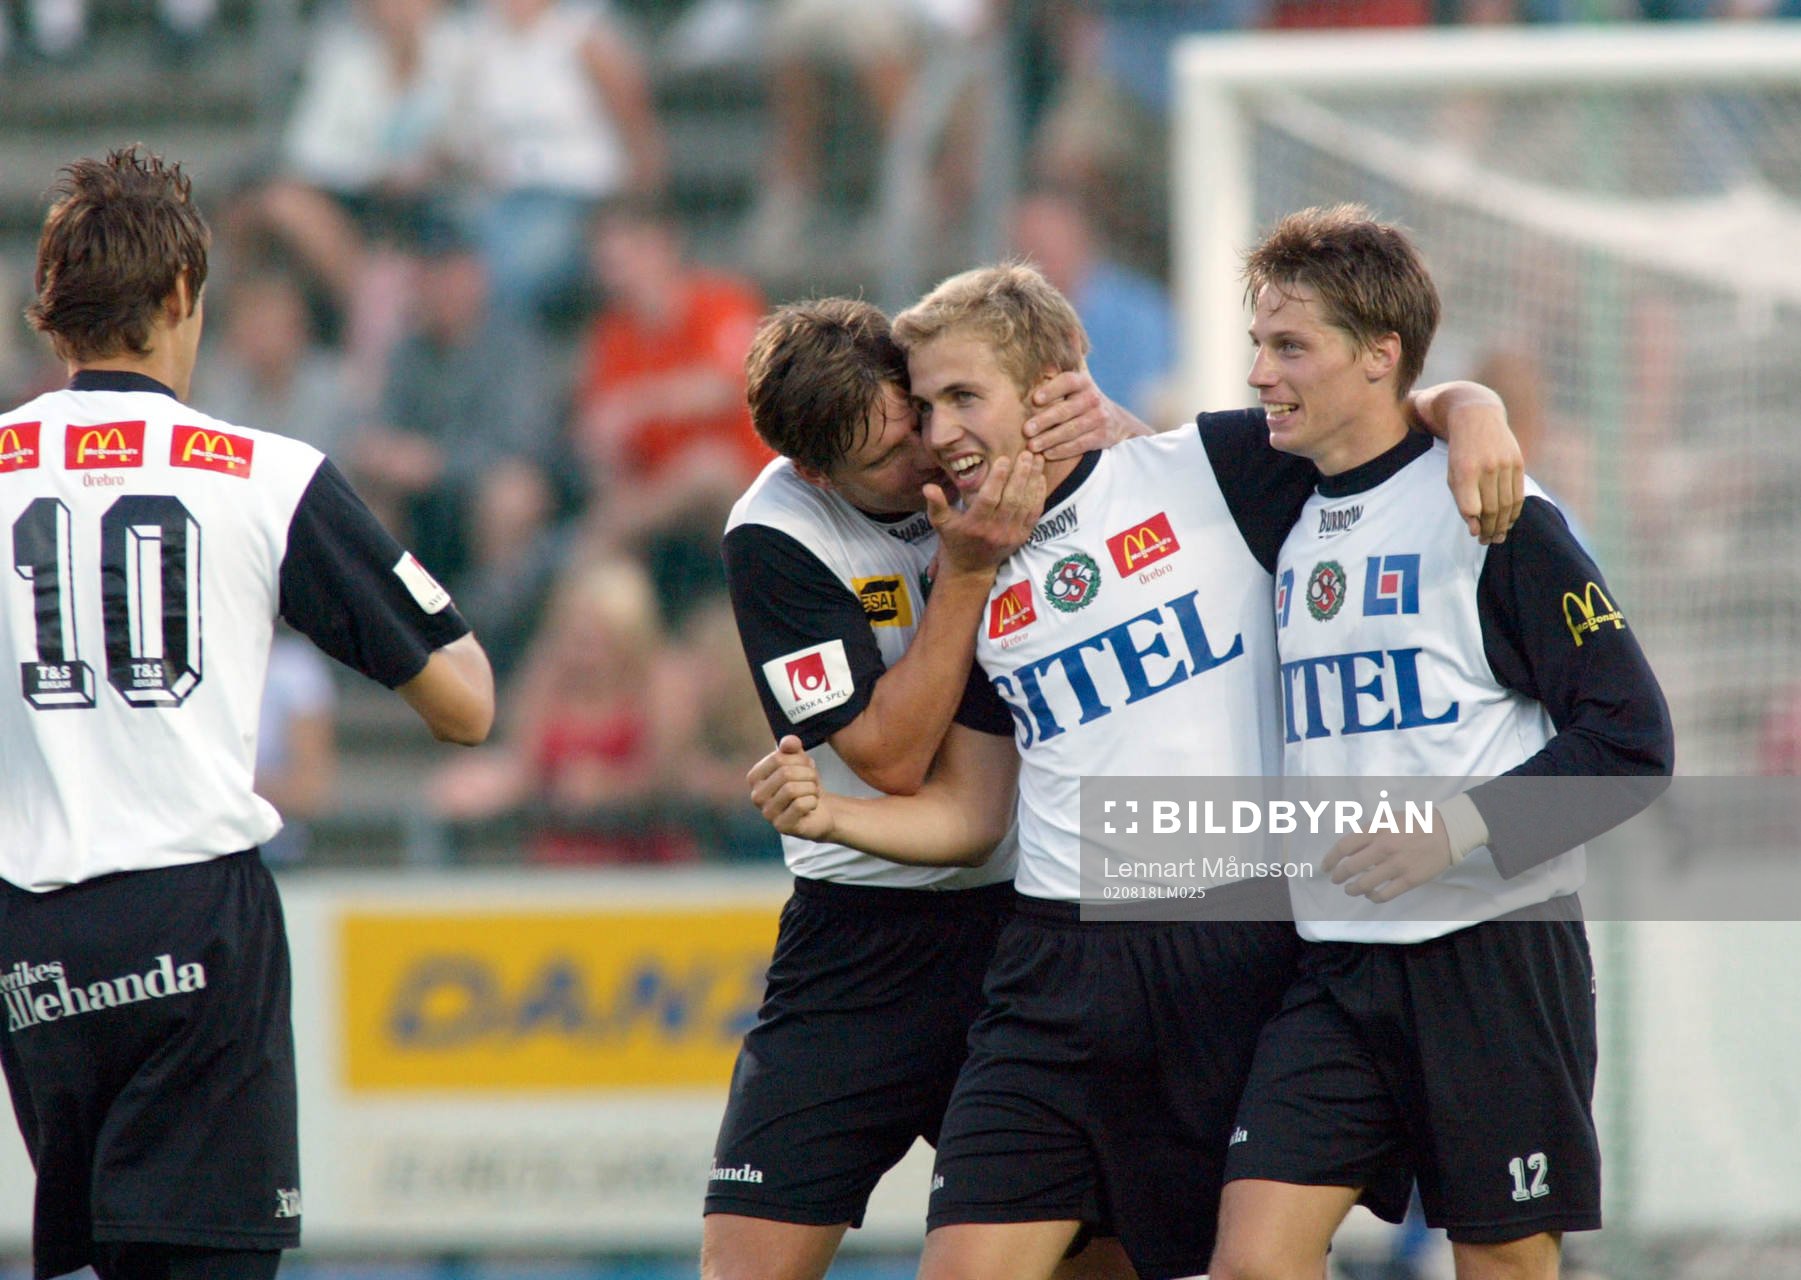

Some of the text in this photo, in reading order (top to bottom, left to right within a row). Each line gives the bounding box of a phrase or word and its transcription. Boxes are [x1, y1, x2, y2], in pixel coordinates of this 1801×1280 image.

[1317, 505, 1364, 534] BURROW
[13, 494, 202, 710] 10
[36, 665, 72, 680] T&S
[130, 664, 164, 679] T&S
[993, 589, 1245, 750] SITEL
[0, 960, 65, 993] rikes
[4, 953, 207, 1033] Allehanda
[1508, 1151, 1551, 1202] 12
